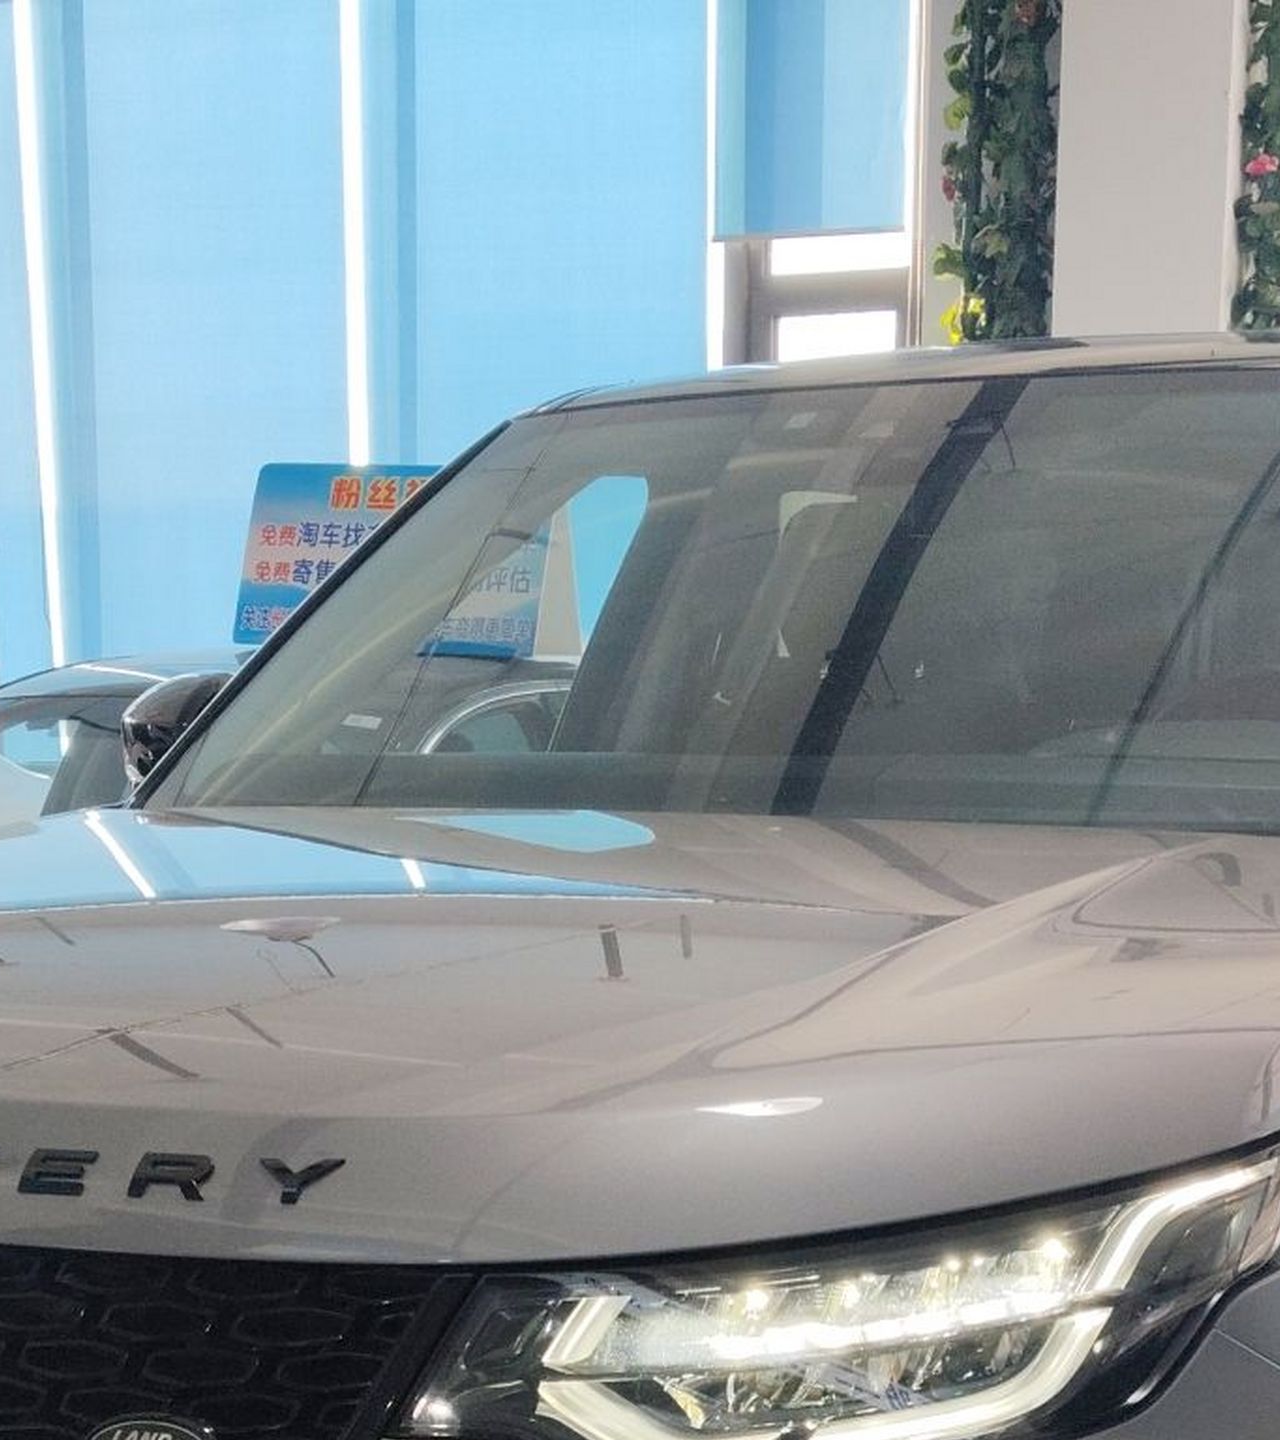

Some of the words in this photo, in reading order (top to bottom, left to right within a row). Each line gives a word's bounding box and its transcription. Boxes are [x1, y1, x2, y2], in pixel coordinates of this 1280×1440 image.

[261, 521, 375, 548] 免费淘车找
